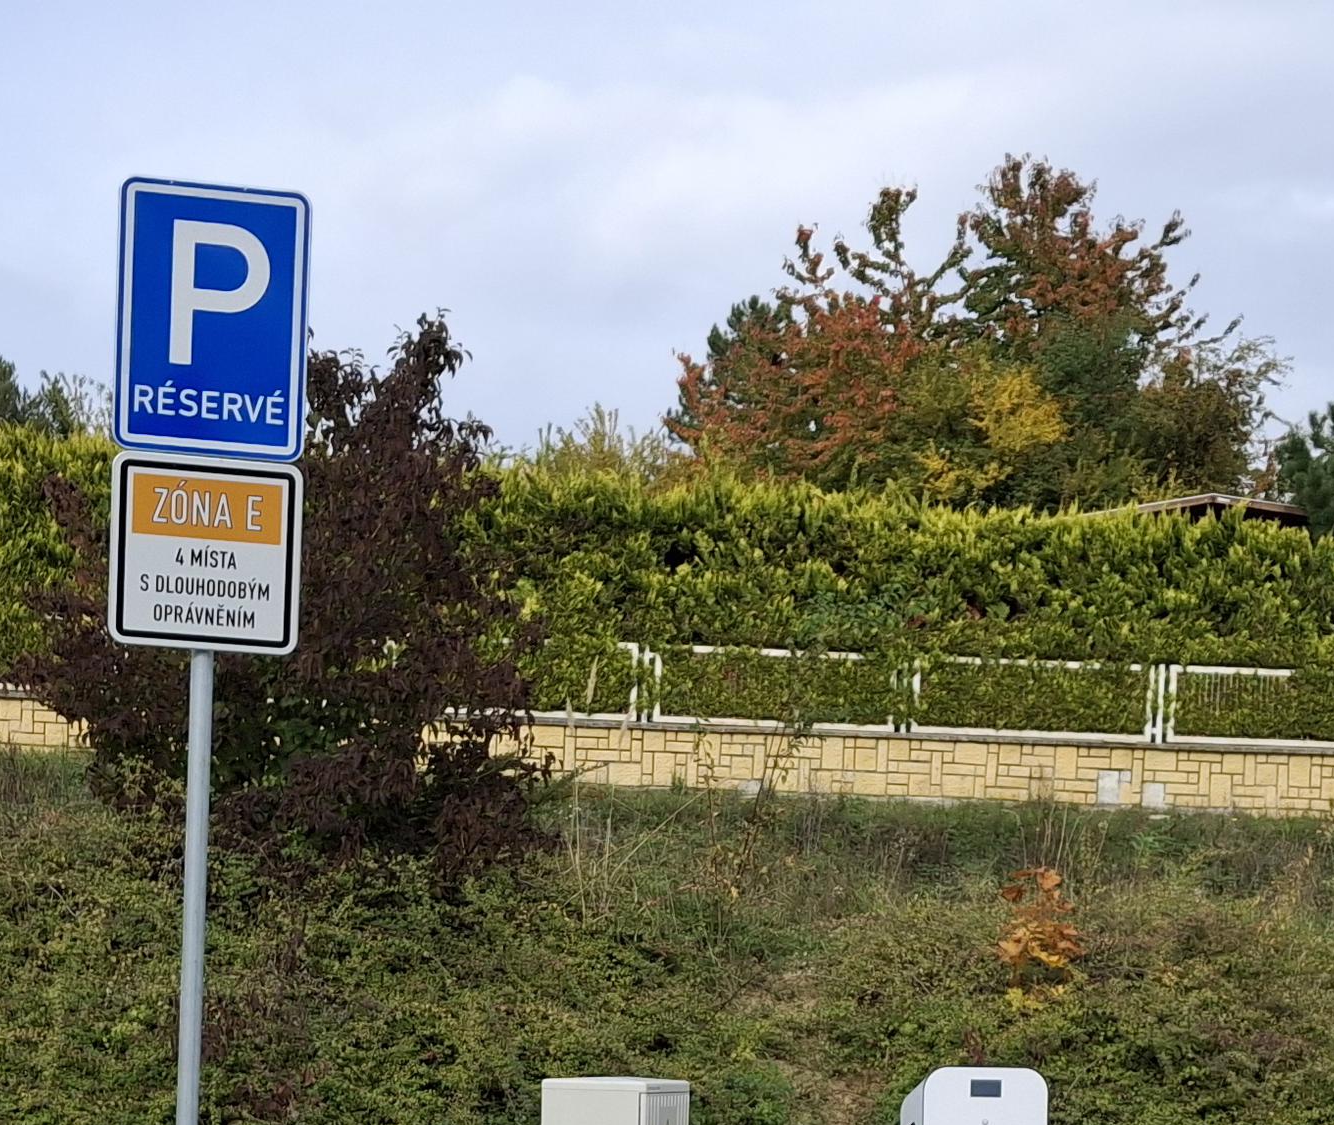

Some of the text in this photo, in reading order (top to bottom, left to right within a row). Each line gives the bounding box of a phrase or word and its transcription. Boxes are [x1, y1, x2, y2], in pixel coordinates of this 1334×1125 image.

[169, 218, 271, 366] P
[133, 380, 285, 426] RÉSERVÉ
[152, 480, 264, 532] ZÓNA E
[175, 545, 237, 570] 4 MÍSTA
[140, 573, 270, 601] S DLOUHODOBÝM
[153, 602, 256, 629] OPRÁVNĚNÍM
